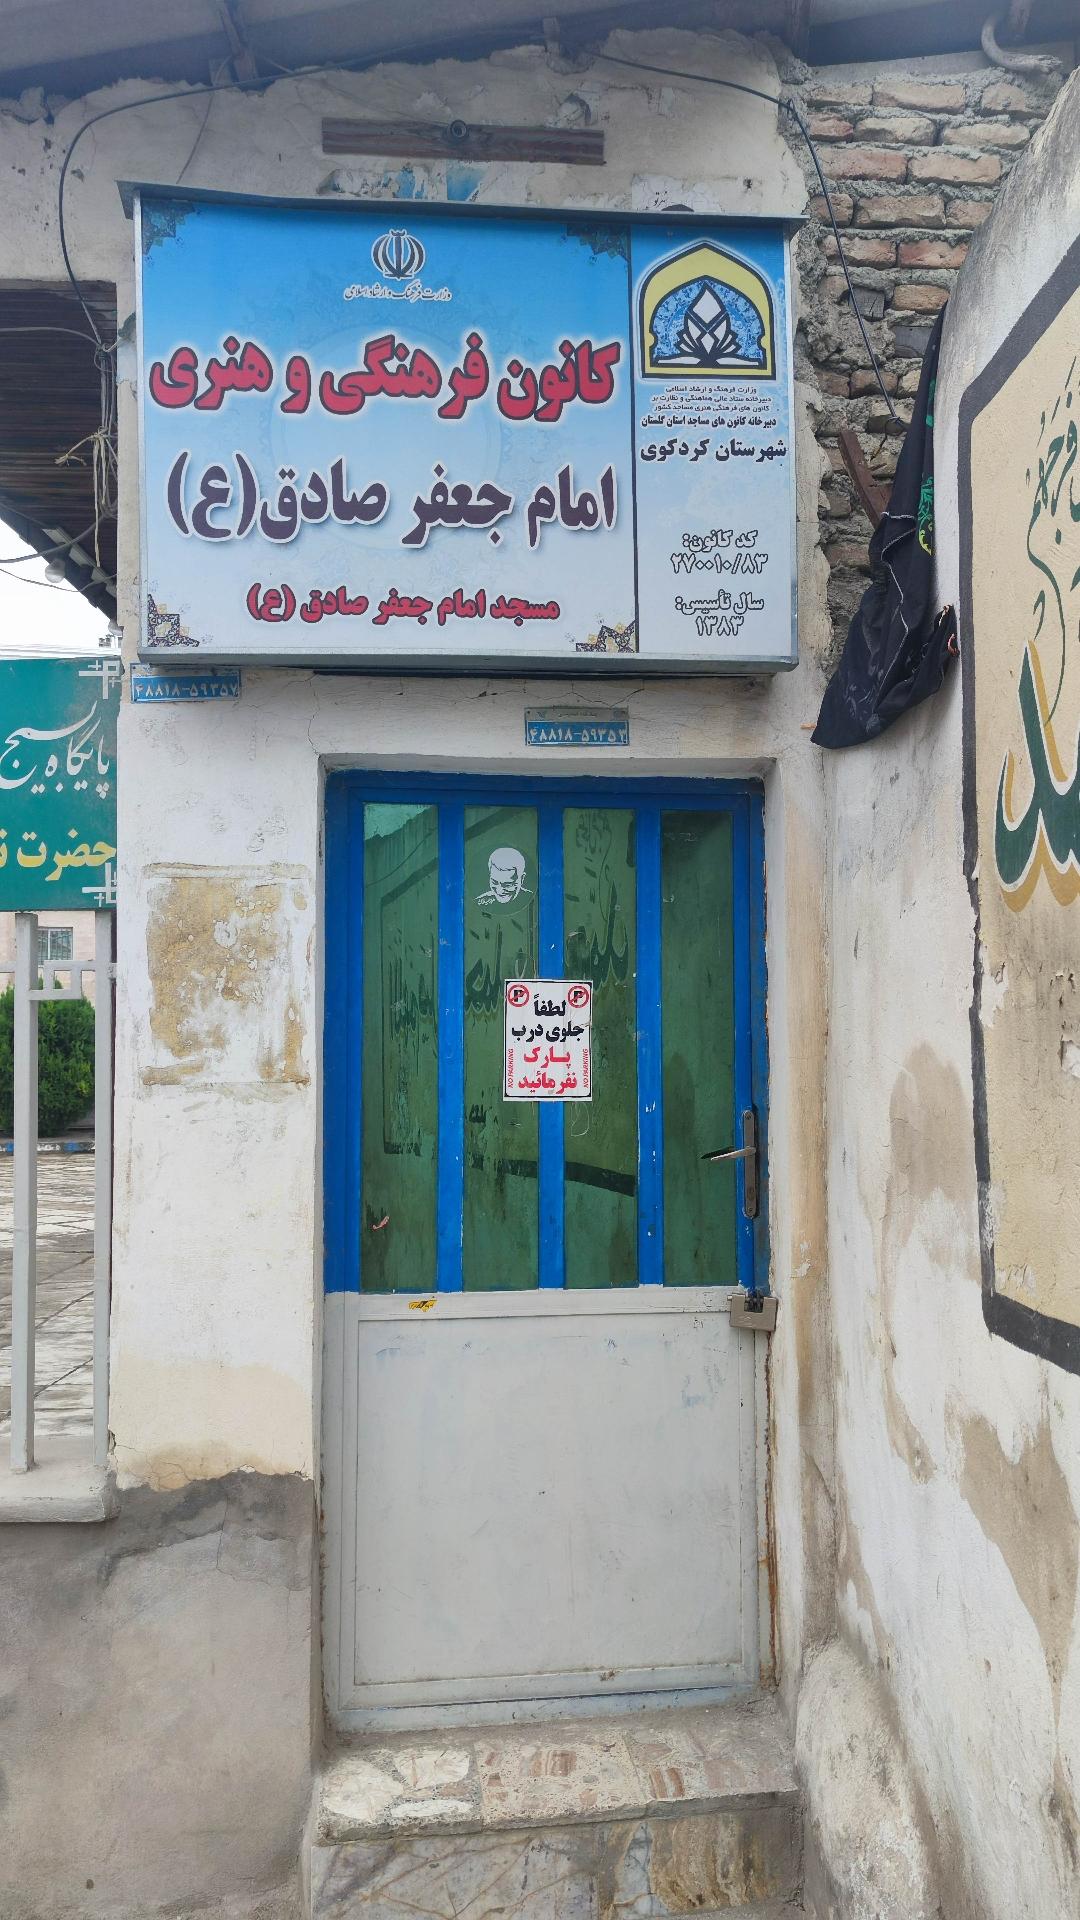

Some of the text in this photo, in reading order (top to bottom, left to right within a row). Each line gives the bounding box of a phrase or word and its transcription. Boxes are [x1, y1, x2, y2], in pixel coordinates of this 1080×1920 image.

[344, 285, 369, 300] اسلامی
[370, 283, 387, 299] ارشاد
[392, 279, 422, 303] فرهنگ
[422, 287, 452, 300] وزارت
[149, 333, 620, 422] کانون فرهنگی و هنری
[662, 394, 680, 402] نظارت
[685, 394, 713, 402] هماهنگی
[713, 394, 728, 402] عالی
[738, 386, 757, 394] وزارت
[654, 403, 672, 412] کشور
[672, 404, 694, 412] مساجد
[712, 404, 737, 412] فرهنگی
[745, 396, 772, 404] دبیرخانه
[752, 405, 770, 413] کانون
[641, 415, 776, 428] دبیرخانه کانون های مساجد استان گلستان
[640, 438, 787, 463] شهرستان کردکوی
[401, 463, 513, 545] جعفر
[527, 463, 616, 549] امام
[682, 529, 758, 553] کد کانون:
[670, 553, 769, 574] ۲۷۰۰۱۰/۸۳
[247, 582, 560, 626] مسجد امام جعفر صادق (ع)
[675, 589, 765, 615] سال تأسیس:
[695, 616, 745, 636] ۱۳۸۳
[0, 700, 110, 799] پایگاه بسیج
[17, 828, 117, 881] حضرت
[511, 1020, 585, 1043] جلوی درب
[523, 1045, 571, 1069] پارک
[507, 1078, 514, 1089] NO
[517, 1070, 578, 1094] نفرمائید
[583, 1078, 589, 1089] NO
